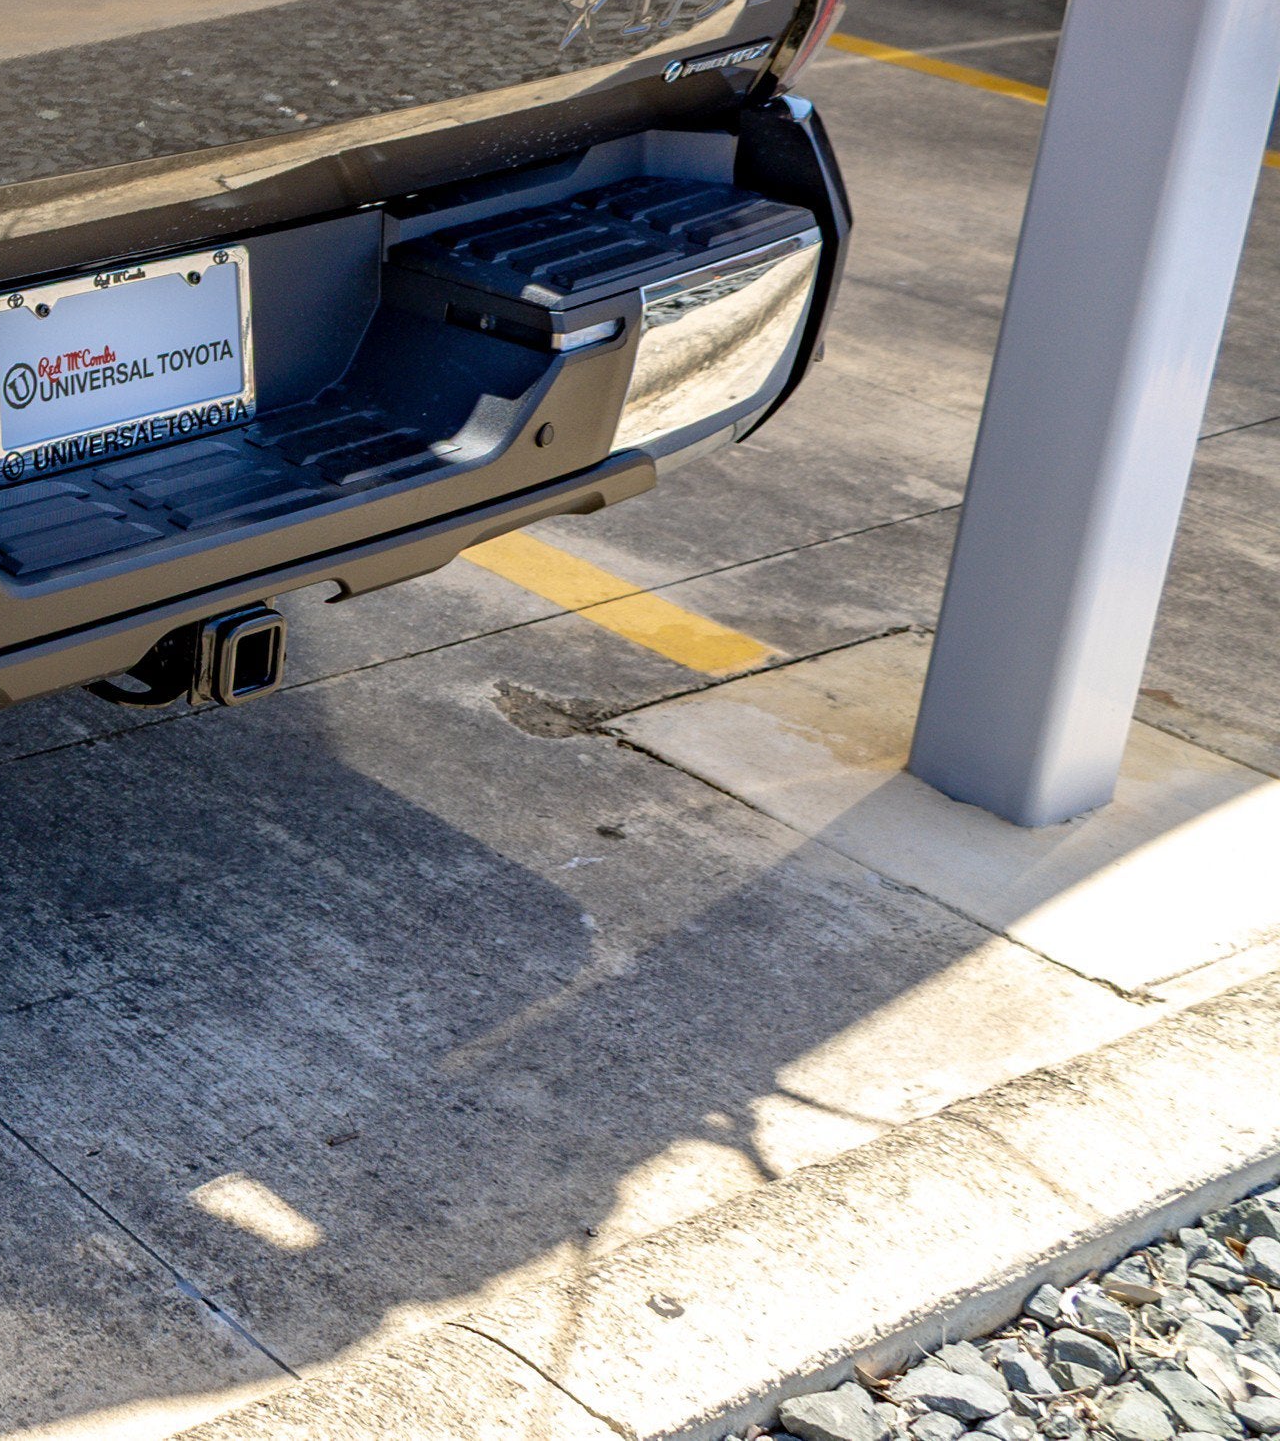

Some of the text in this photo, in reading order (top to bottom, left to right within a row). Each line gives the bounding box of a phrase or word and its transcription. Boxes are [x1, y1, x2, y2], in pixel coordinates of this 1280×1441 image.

[38, 345, 116, 383] Red McCombs
[40, 360, 154, 402] UNIVERSAL
[157, 339, 234, 374] TOYOTA
[32, 420, 163, 471] UNIVERSAL
[165, 398, 249, 437] TOYOTA
